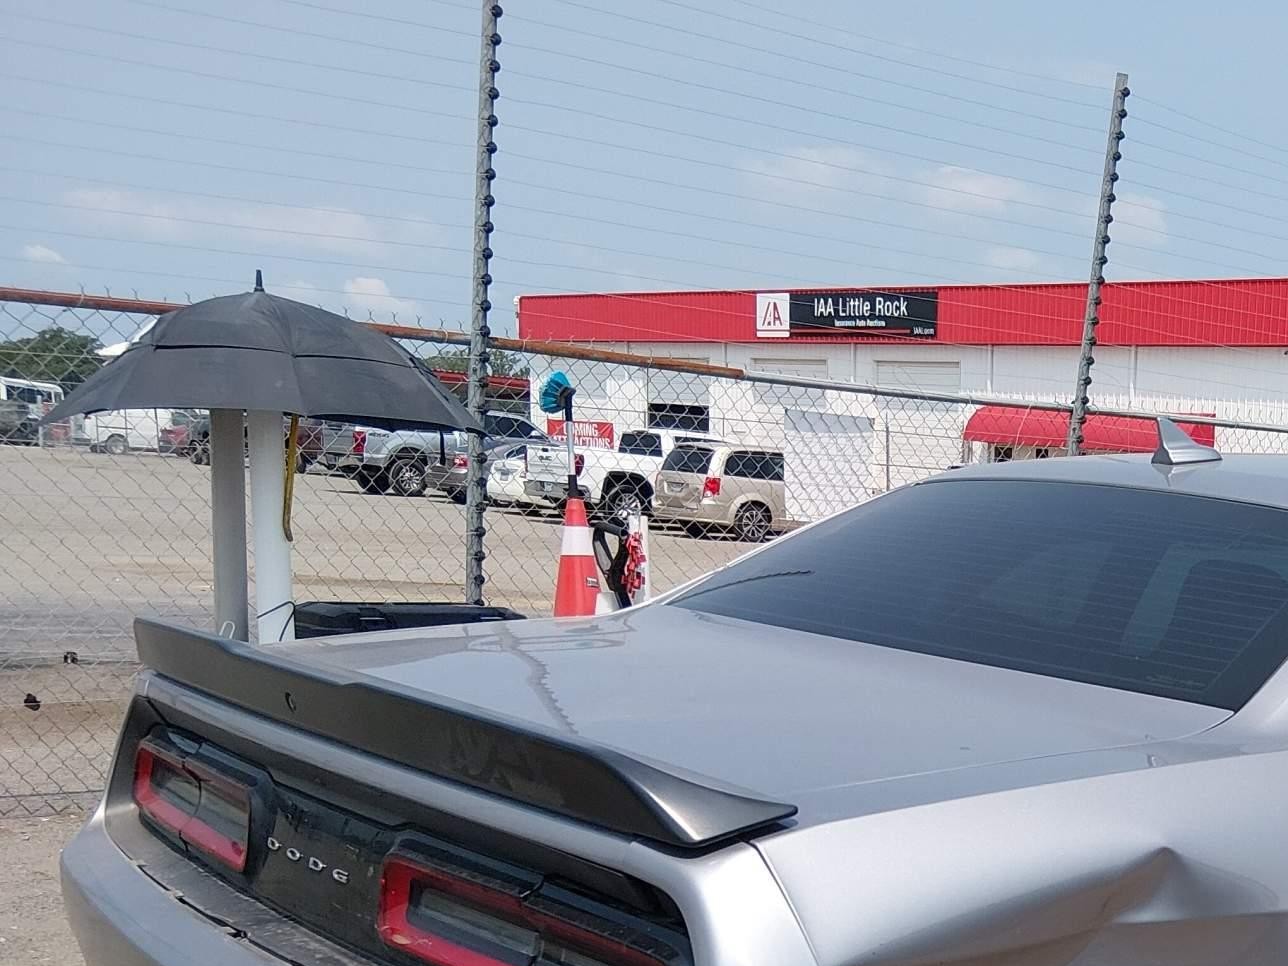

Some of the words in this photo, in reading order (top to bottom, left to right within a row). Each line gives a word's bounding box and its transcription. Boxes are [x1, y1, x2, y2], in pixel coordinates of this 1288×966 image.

[814, 298, 834, 317] IAA
[839, 298, 870, 317] Little
[876, 298, 908, 317] Rock
